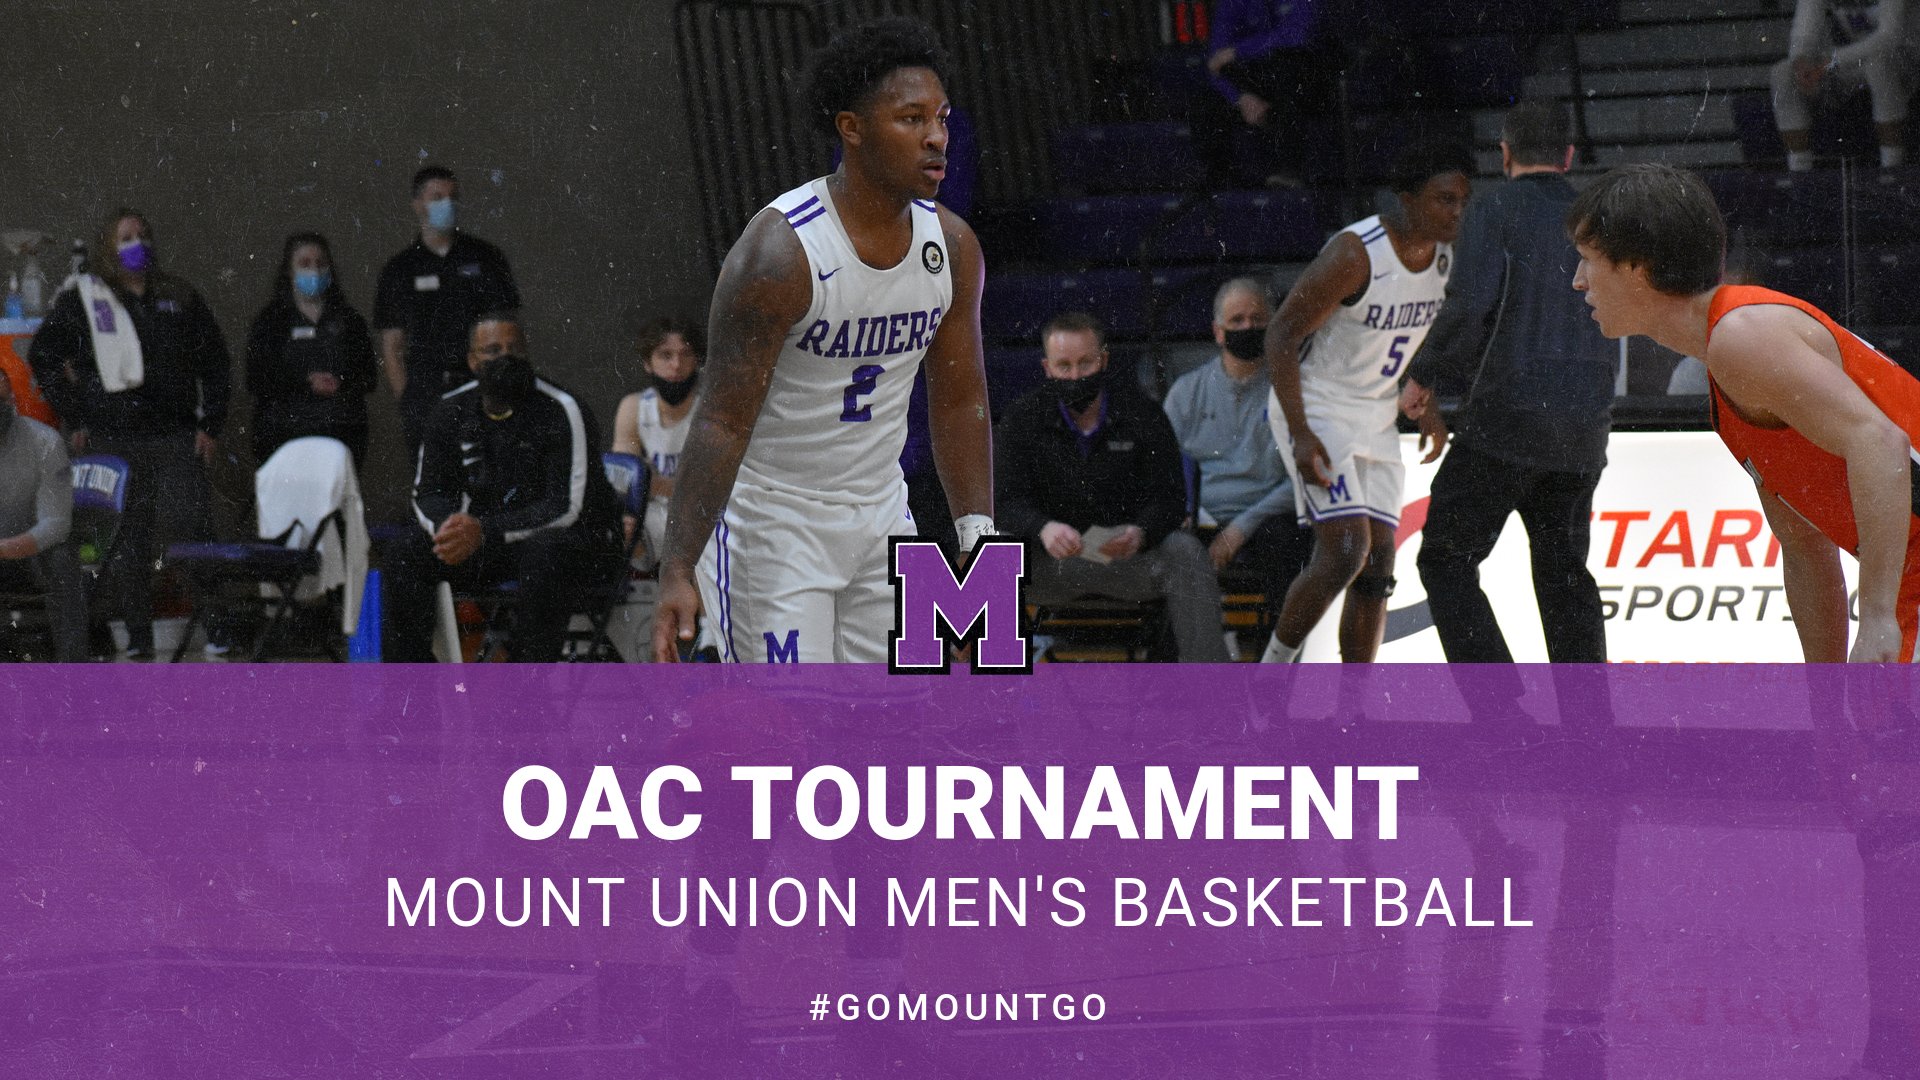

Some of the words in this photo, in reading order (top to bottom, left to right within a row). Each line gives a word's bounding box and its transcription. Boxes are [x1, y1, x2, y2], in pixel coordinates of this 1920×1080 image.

[796, 307, 941, 358] RAIDERS
[1363, 299, 1442, 330] RAIDER
[1381, 335, 1410, 377] 5
[840, 365, 886, 422] 2
[1329, 474, 1352, 504] M
[1590, 510, 1782, 568] TAR
[763, 629, 801, 676] M
